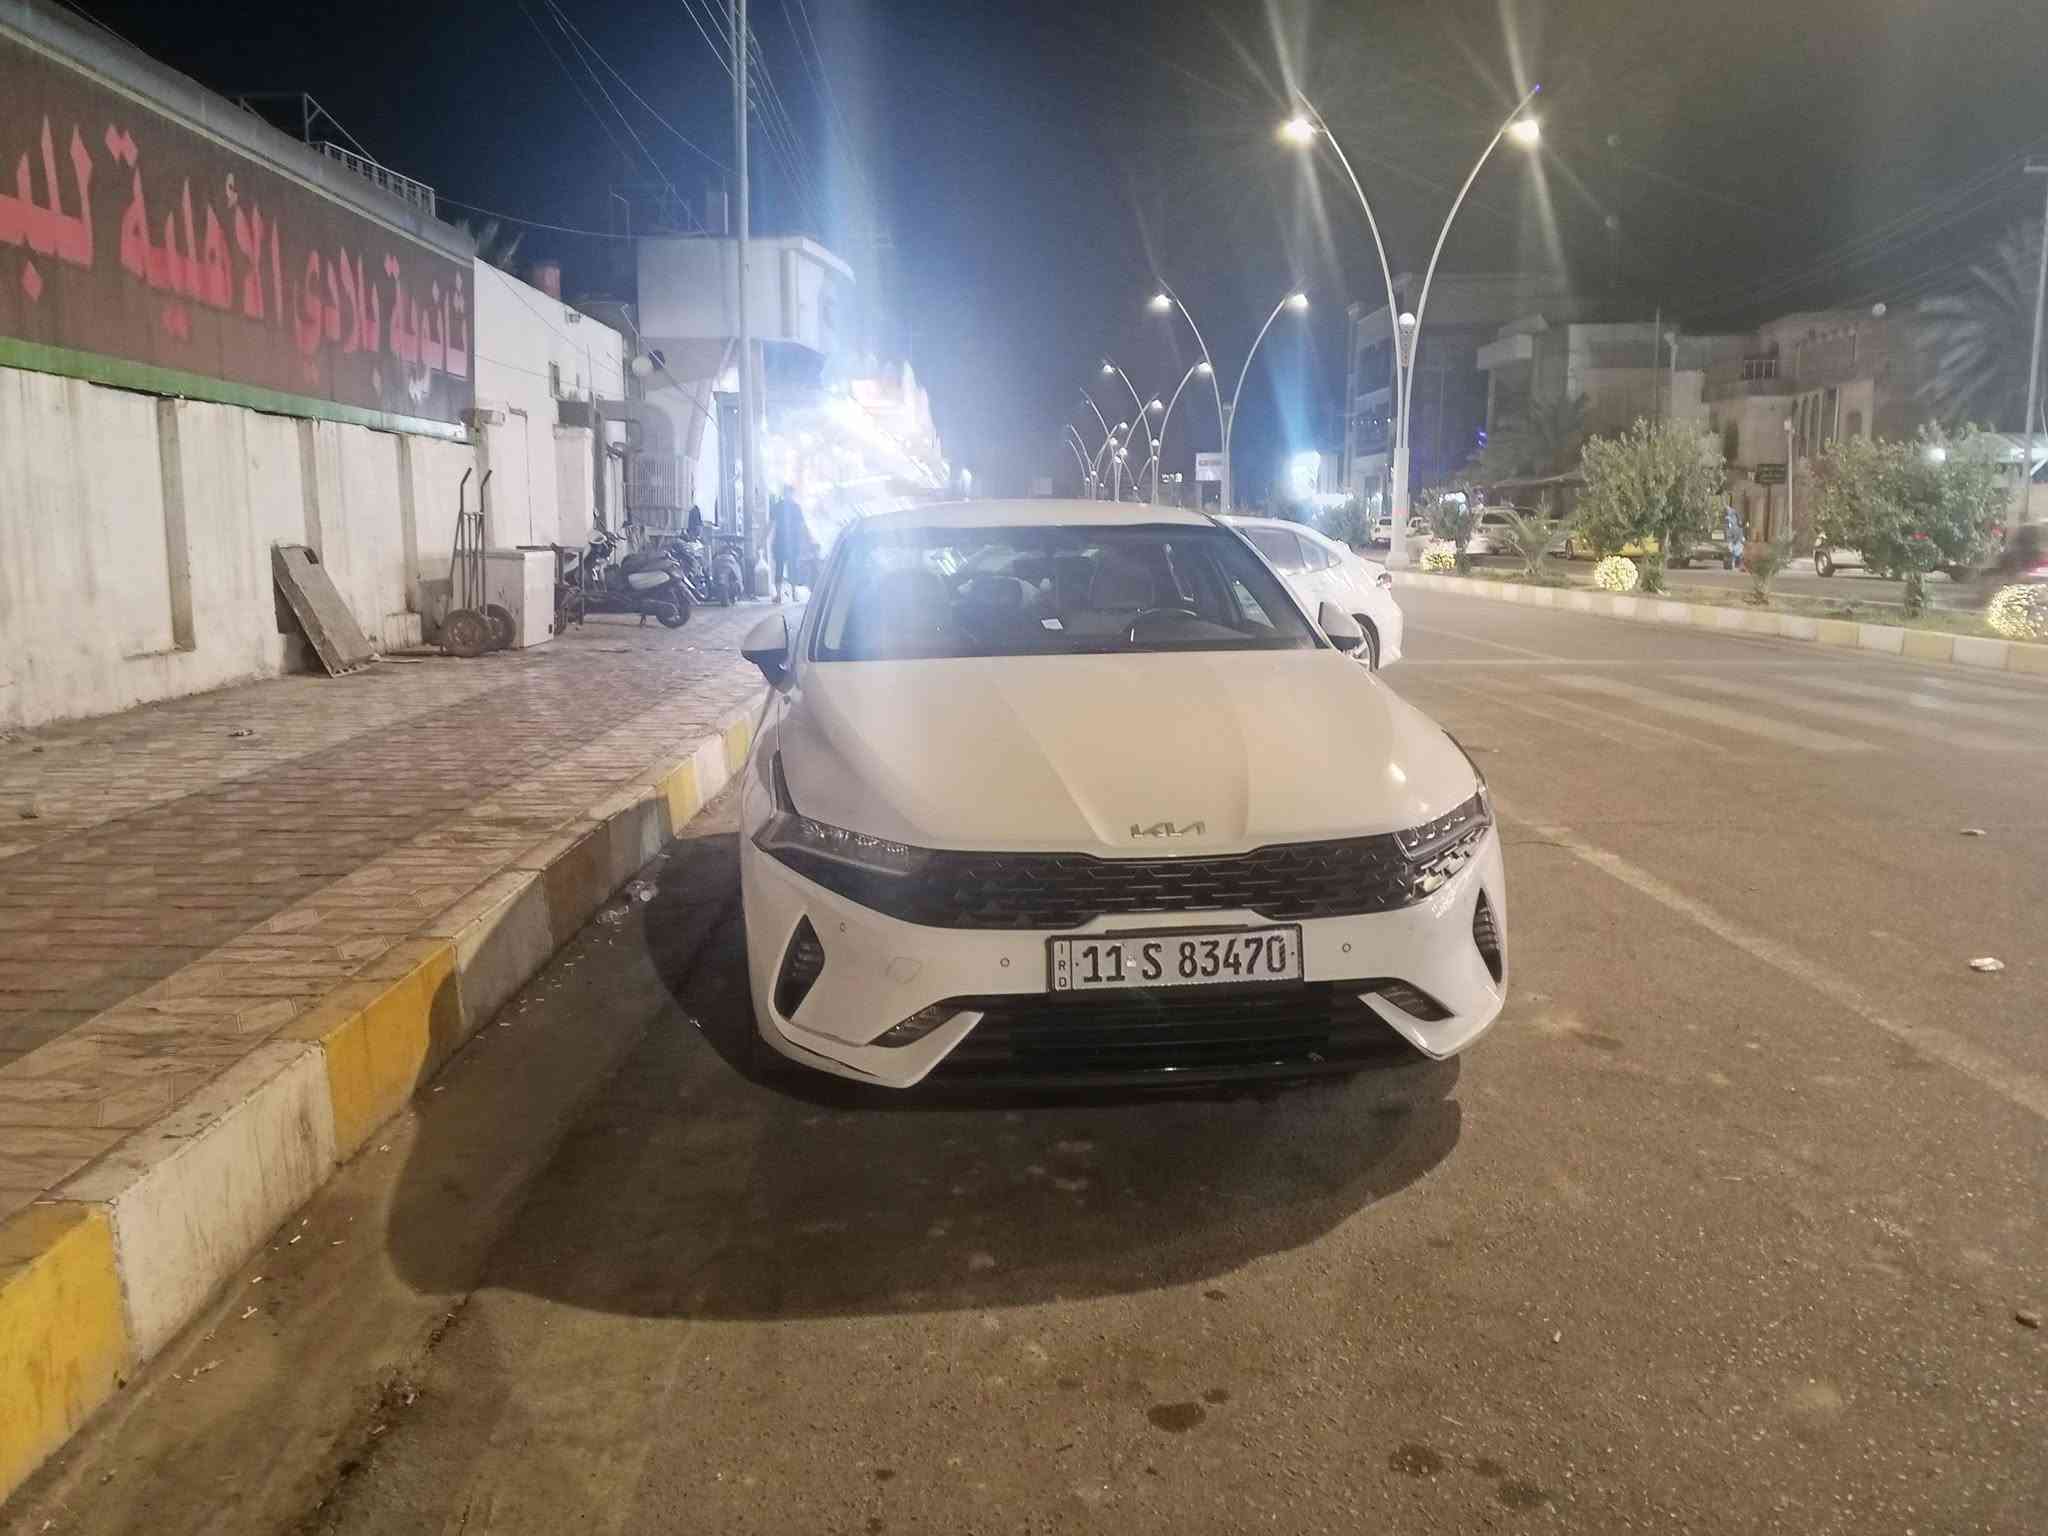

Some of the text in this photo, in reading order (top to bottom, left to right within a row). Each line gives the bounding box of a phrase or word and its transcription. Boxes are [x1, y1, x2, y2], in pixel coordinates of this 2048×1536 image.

[0, 112, 94, 302] للب
[1129, 820, 1206, 840] KIA
[1082, 934, 1287, 984] 11 S 83470
